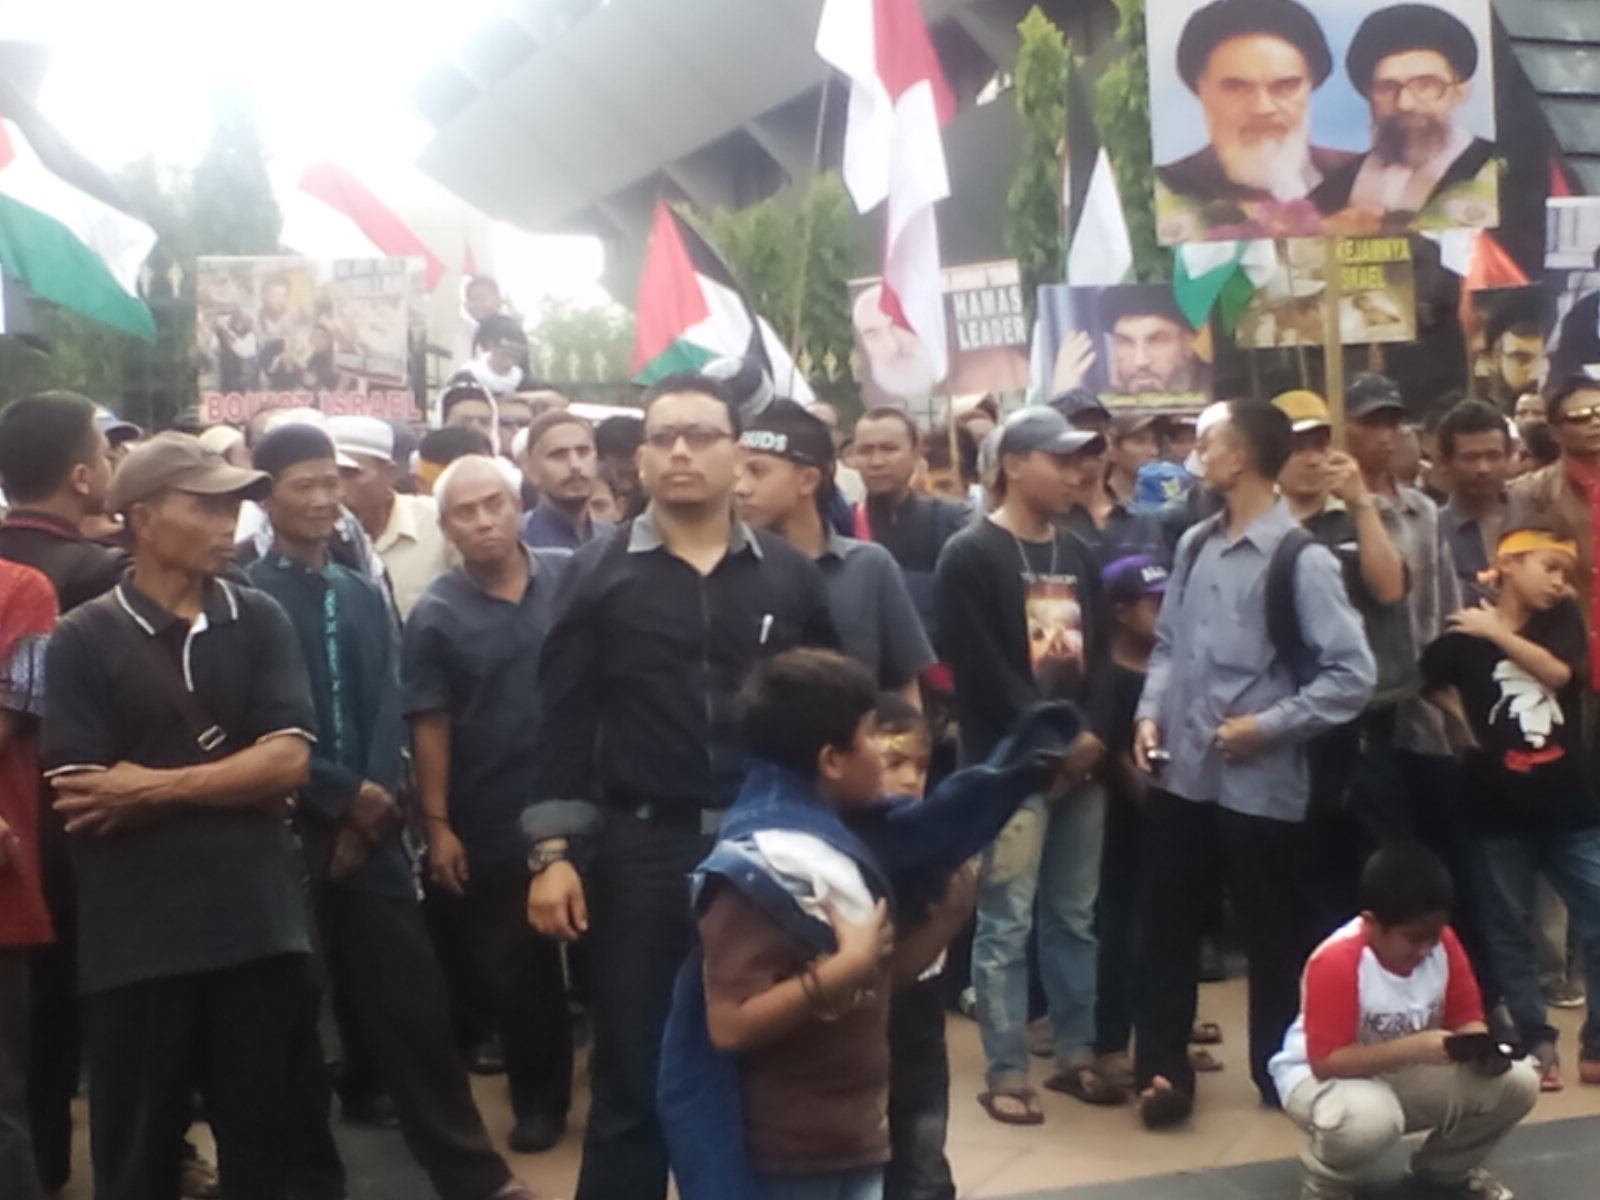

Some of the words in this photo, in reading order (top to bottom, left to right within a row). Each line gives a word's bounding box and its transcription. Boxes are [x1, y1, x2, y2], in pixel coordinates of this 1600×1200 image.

[953, 285, 1023, 321] HAMAS
[957, 315, 1027, 350] LEADER
[319, 388, 422, 419] ISRAEL
